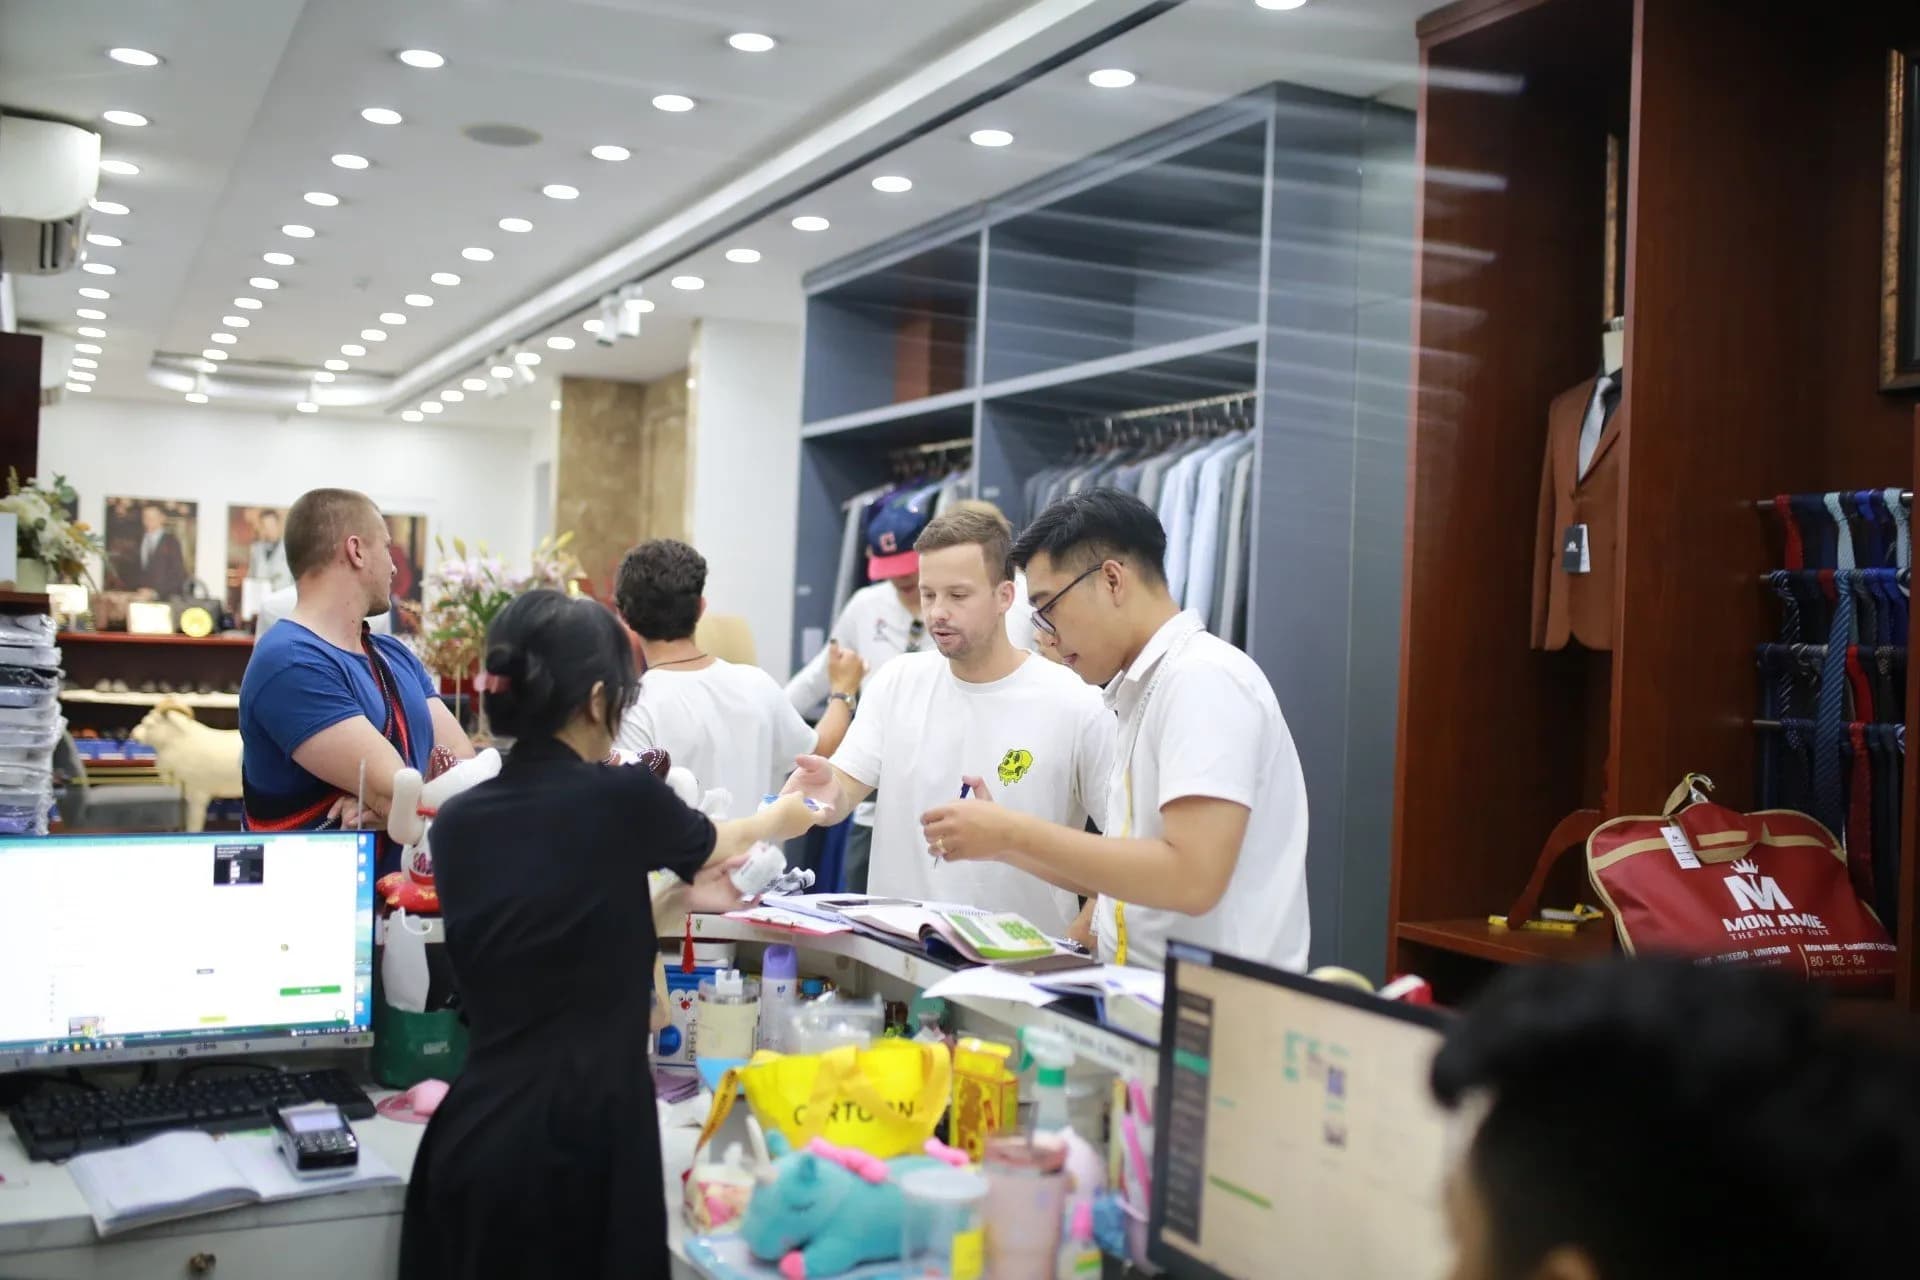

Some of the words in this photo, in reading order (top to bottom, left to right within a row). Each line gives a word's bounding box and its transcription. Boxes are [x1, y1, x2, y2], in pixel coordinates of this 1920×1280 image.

[880, 532, 897, 553] C
[1721, 915, 1773, 931] MON
[1780, 913, 1826, 929] AMIE
[1729, 931, 1755, 941] THE
[1758, 928, 1786, 936] KING
[1790, 927, 1804, 935] OF
[1753, 945, 1791, 957] UNIFORM
[1832, 954, 1846, 966] 82
